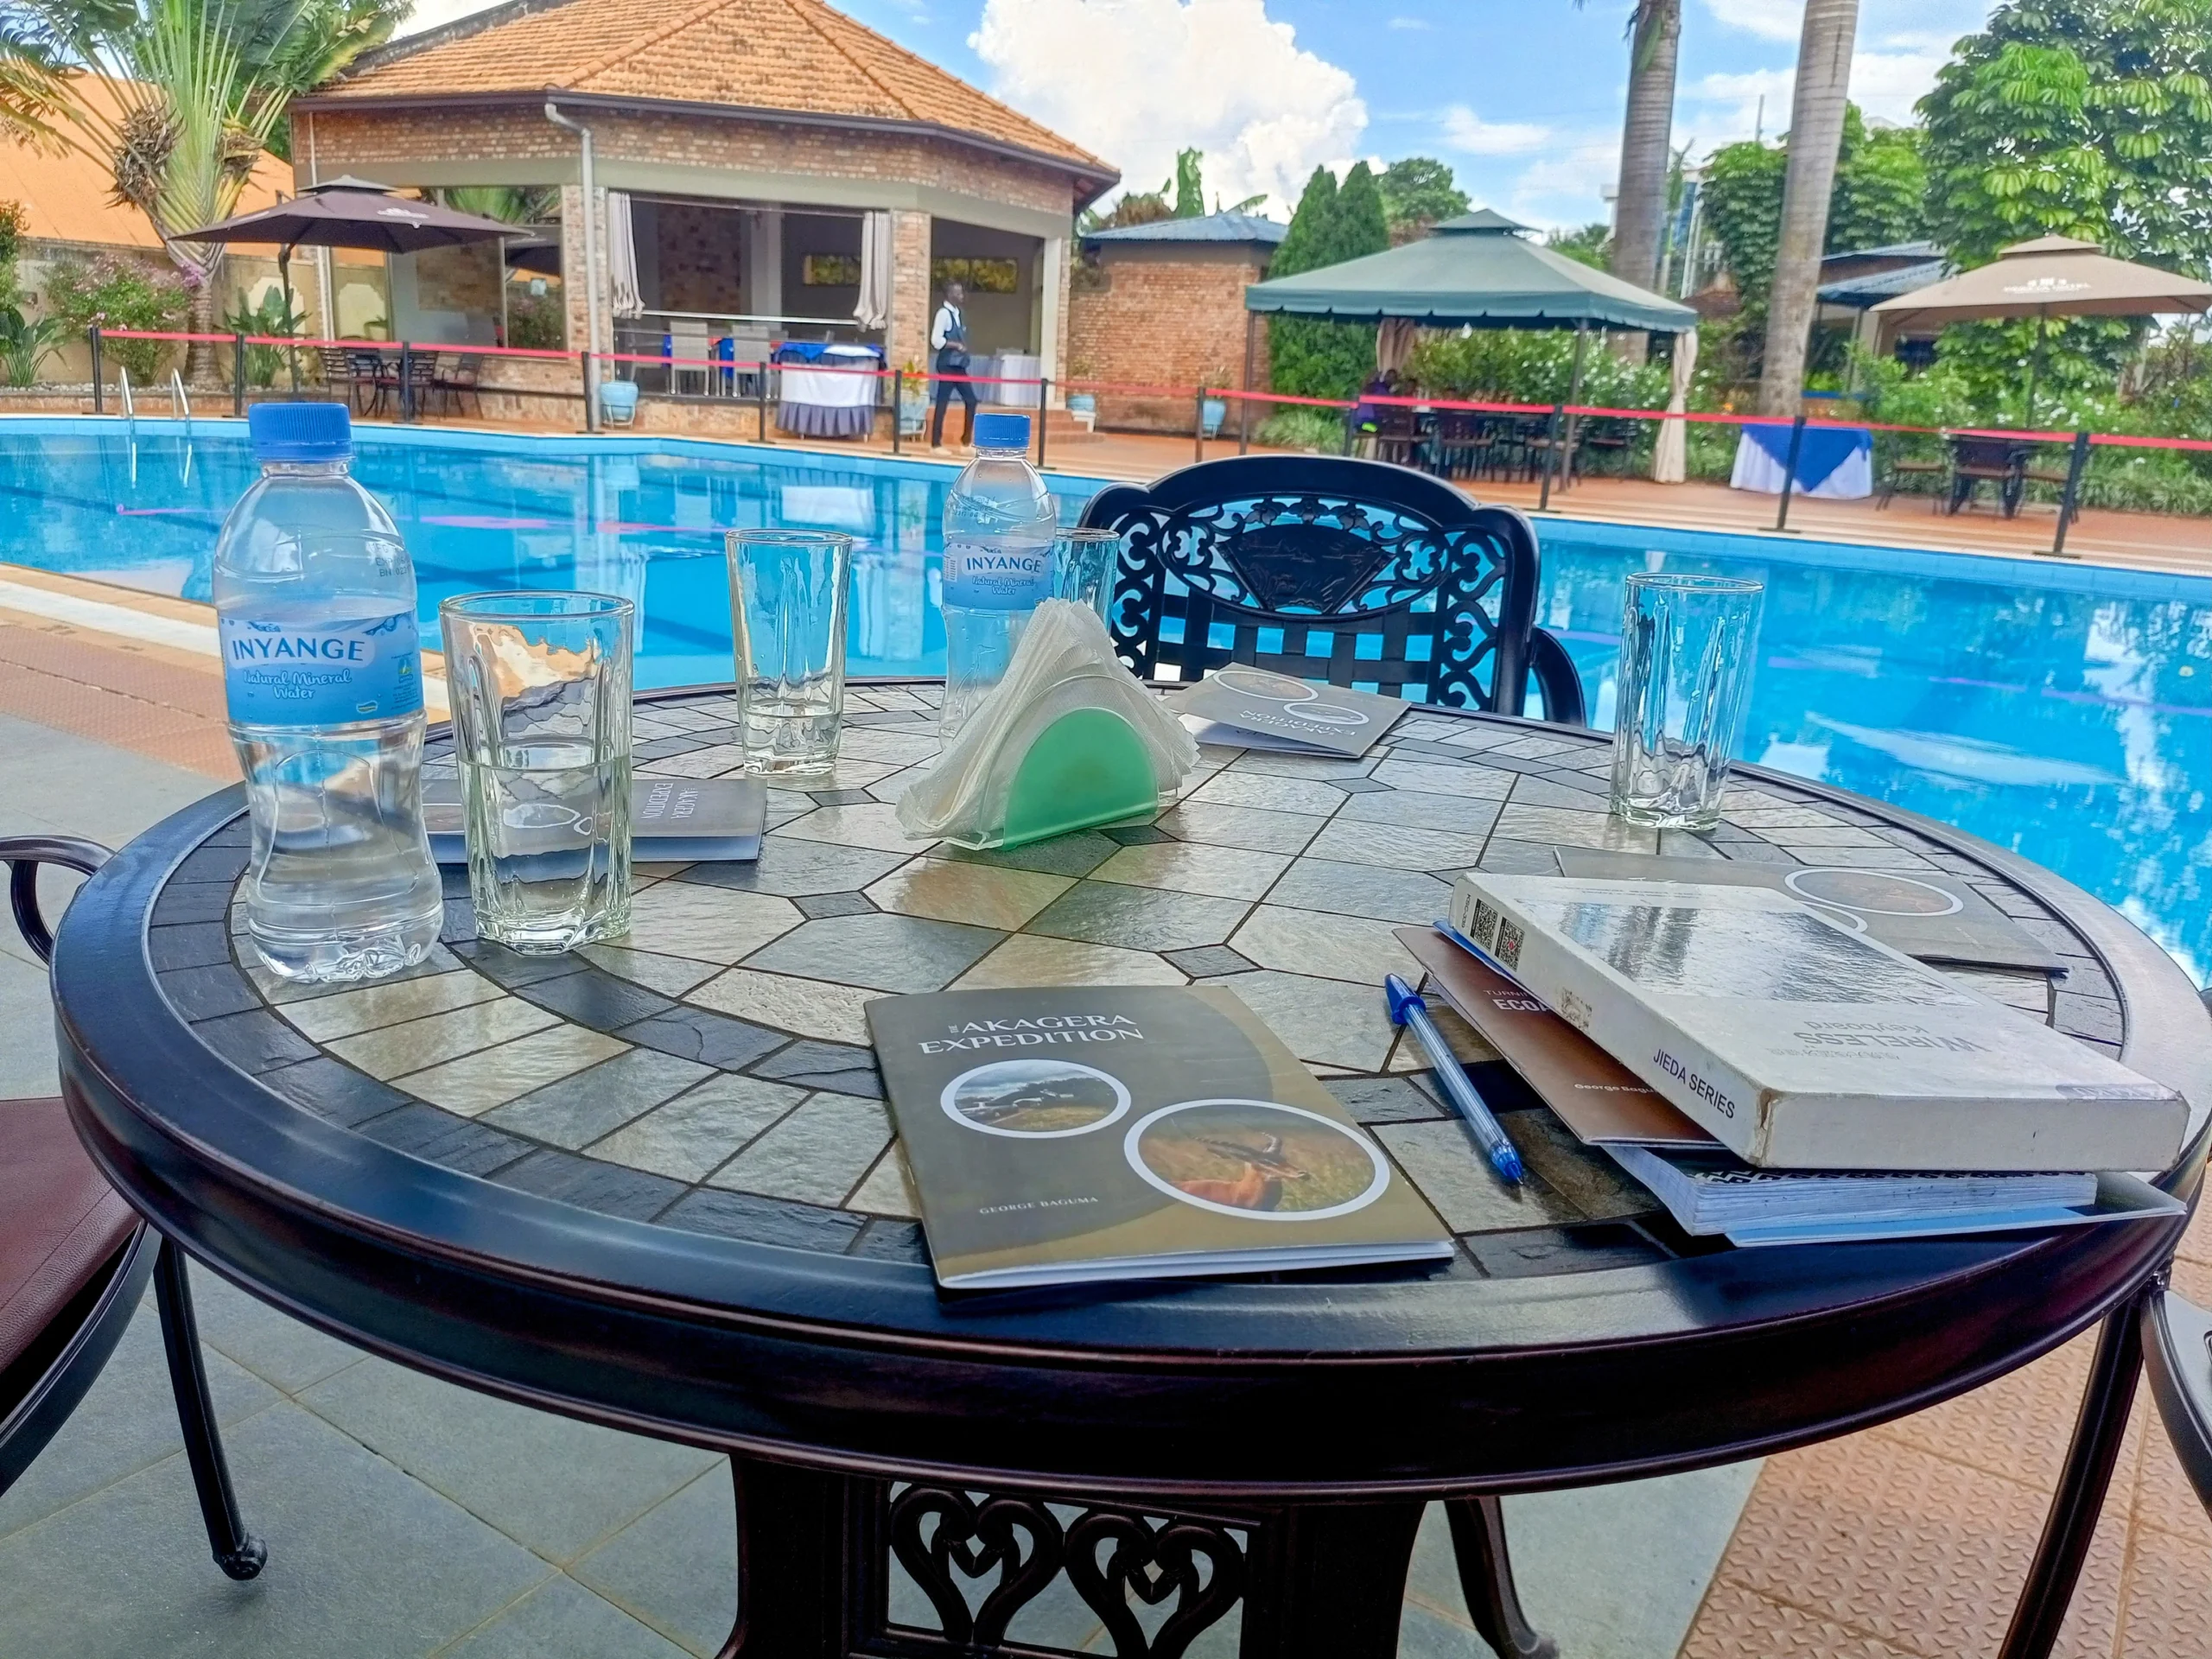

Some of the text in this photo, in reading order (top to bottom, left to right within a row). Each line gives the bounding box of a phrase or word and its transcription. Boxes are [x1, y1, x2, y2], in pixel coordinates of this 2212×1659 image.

[966, 556, 1042, 573] INYANGE
[972, 575, 1036, 586] Natural Mineral
[991, 587, 1016, 595] Water
[232, 638, 365, 662] INYANGE
[244, 668, 353, 686] Natural Mineral
[273, 685, 316, 700] Water
[640, 783, 674, 819] EXPEDITION
[671, 790, 698, 819] AKAGERA
[962, 1014, 1137, 1034] AKAGERA
[1803, 1020, 1930, 1035] Keyboard
[918, 1027, 1145, 1054] EXPEDITION
[1792, 1031, 1993, 1052] WIRELESS
[1573, 1084, 1620, 1092] George
[1653, 1048, 1736, 1119] JIEDA SERIES
[979, 1196, 1099, 1215] GEORGE BAGUMA
